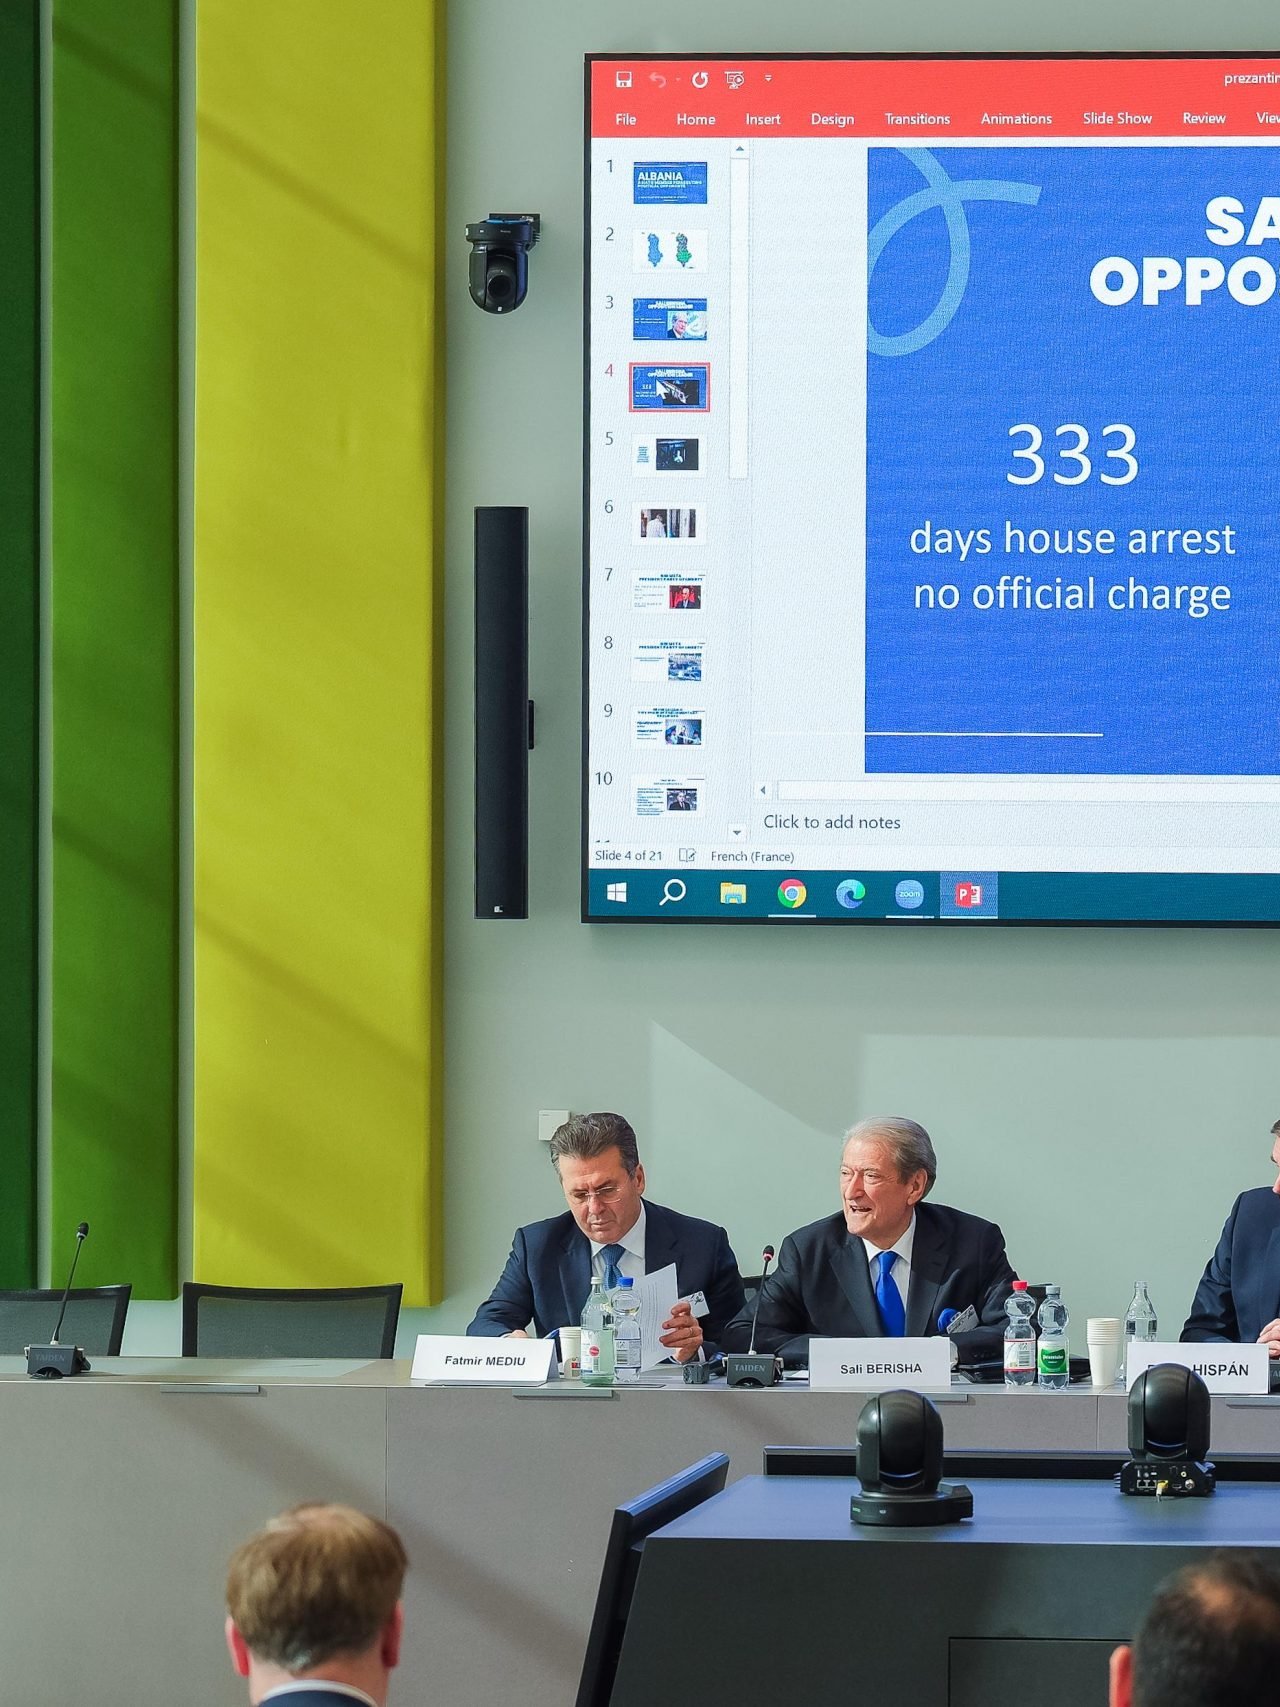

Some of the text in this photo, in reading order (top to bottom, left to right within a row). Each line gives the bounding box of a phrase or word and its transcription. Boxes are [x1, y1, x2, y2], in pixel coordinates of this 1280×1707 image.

[616, 113, 636, 125] File
[677, 113, 716, 125] Home
[746, 113, 781, 125] Insert
[812, 113, 855, 128] Design
[885, 113, 950, 124] Transitions
[981, 113, 1052, 124] Animations
[1084, 112, 1152, 124] Slide Show
[1183, 112, 1226, 124] Review
[607, 160, 612, 172] 1
[637, 171, 683, 181] ALBANIA
[606, 227, 613, 241] 2
[606, 295, 613, 309] 3
[605, 364, 613, 377] 4
[606, 432, 613, 445] 5
[1006, 423, 1139, 486] 333
[605, 500, 613, 513] 6
[909, 519, 1236, 562] days house arrest
[605, 568, 612, 581] 7
[914, 573, 1232, 619] no official charge
[604, 636, 613, 649] 8
[604, 704, 612, 717] 9
[596, 772, 612, 785] 10
[764, 814, 900, 829] Click to add notes
[596, 850, 661, 861] Slide 4 of 21
[711, 850, 794, 864] French (France)
[445, 1356, 525, 1366] Fatmir MEDIU
[735, 1364, 766, 1372] TAIDEN
[841, 1364, 922, 1374] Sali BERISHA
[1193, 1361, 1249, 1376] HISPÁN
